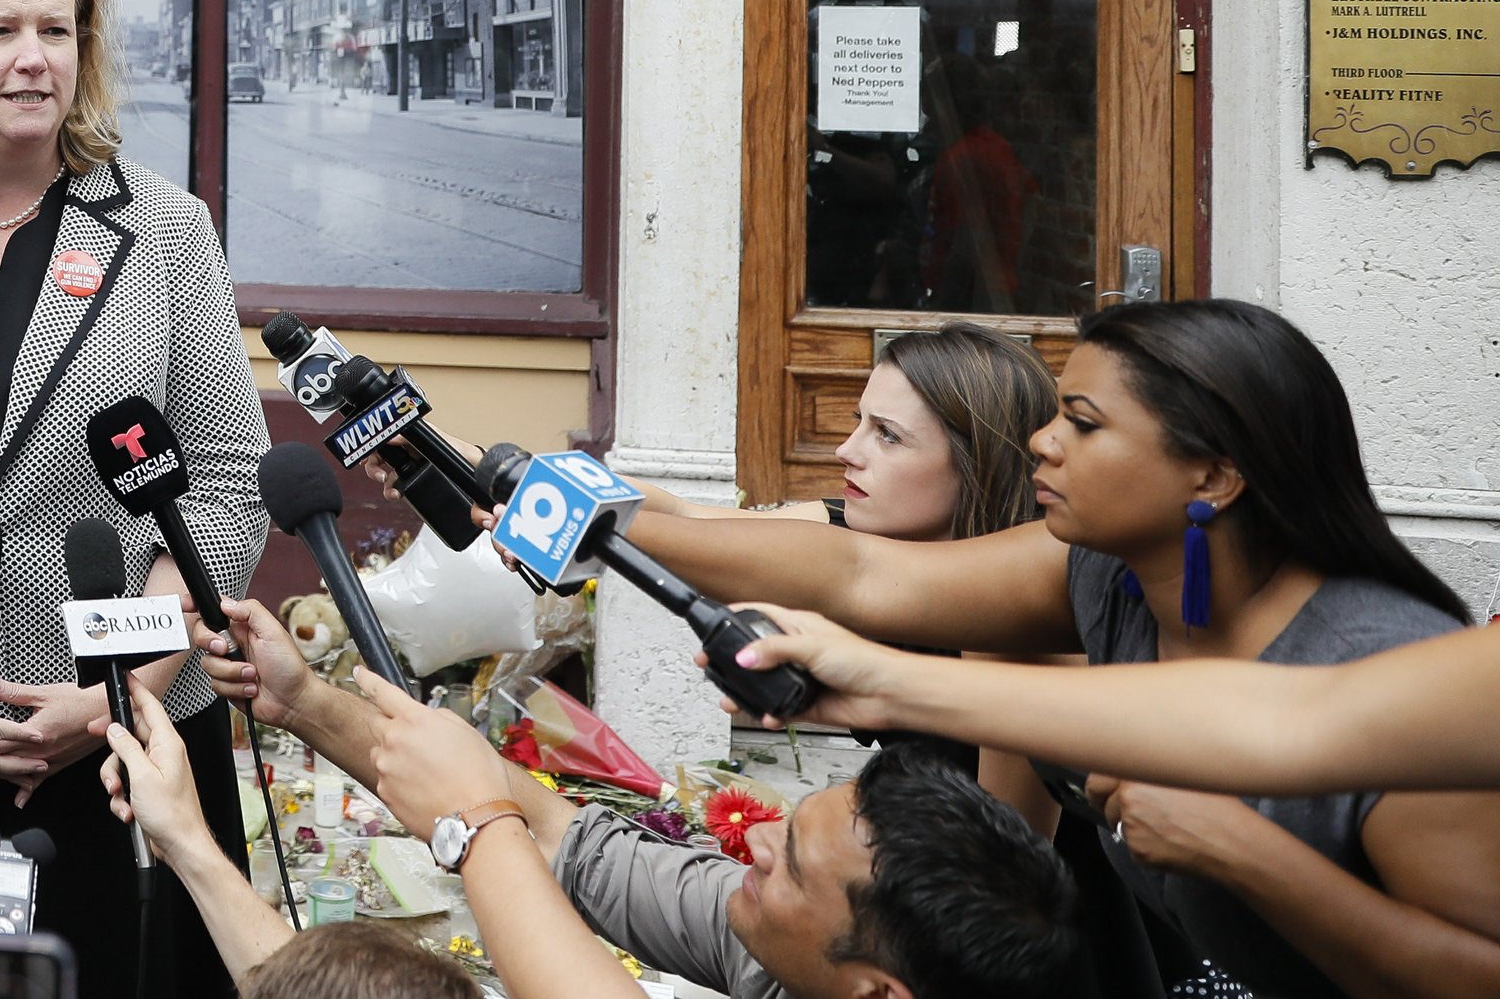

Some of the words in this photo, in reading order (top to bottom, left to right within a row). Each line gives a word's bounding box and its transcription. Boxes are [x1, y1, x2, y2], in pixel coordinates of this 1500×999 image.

[1331, 6, 1362, 17] MARK
[1363, 6, 1373, 17] A.
[1376, 6, 1427, 17] LUTTRELL
[1332, 28, 1362, 39] J&M
[1456, 29, 1488, 40] INC.
[836, 36, 874, 46] Please
[877, 37, 902, 47] take
[833, 50, 847, 59] all
[849, 50, 904, 60] deliveries
[834, 64, 858, 73] next
[861, 64, 887, 74] door
[891, 64, 903, 74] to
[1331, 67, 1365, 78] THIRD
[1368, 68, 1404, 79] FLOOR
[832, 77, 855, 87] Ned
[858, 77, 904, 90] Peppers
[56, 261, 101, 277] SURVIVOR
[350, 414, 411, 462] CINCINNATI
[113, 448, 176, 488] NOTICIAS
[118, 459, 179, 495] TELEMUNDO
[508, 481, 567, 554] 10
[550, 520, 579, 562] WBNS
[84, 618, 108, 633] abc
[108, 613, 173, 633] RADIO
